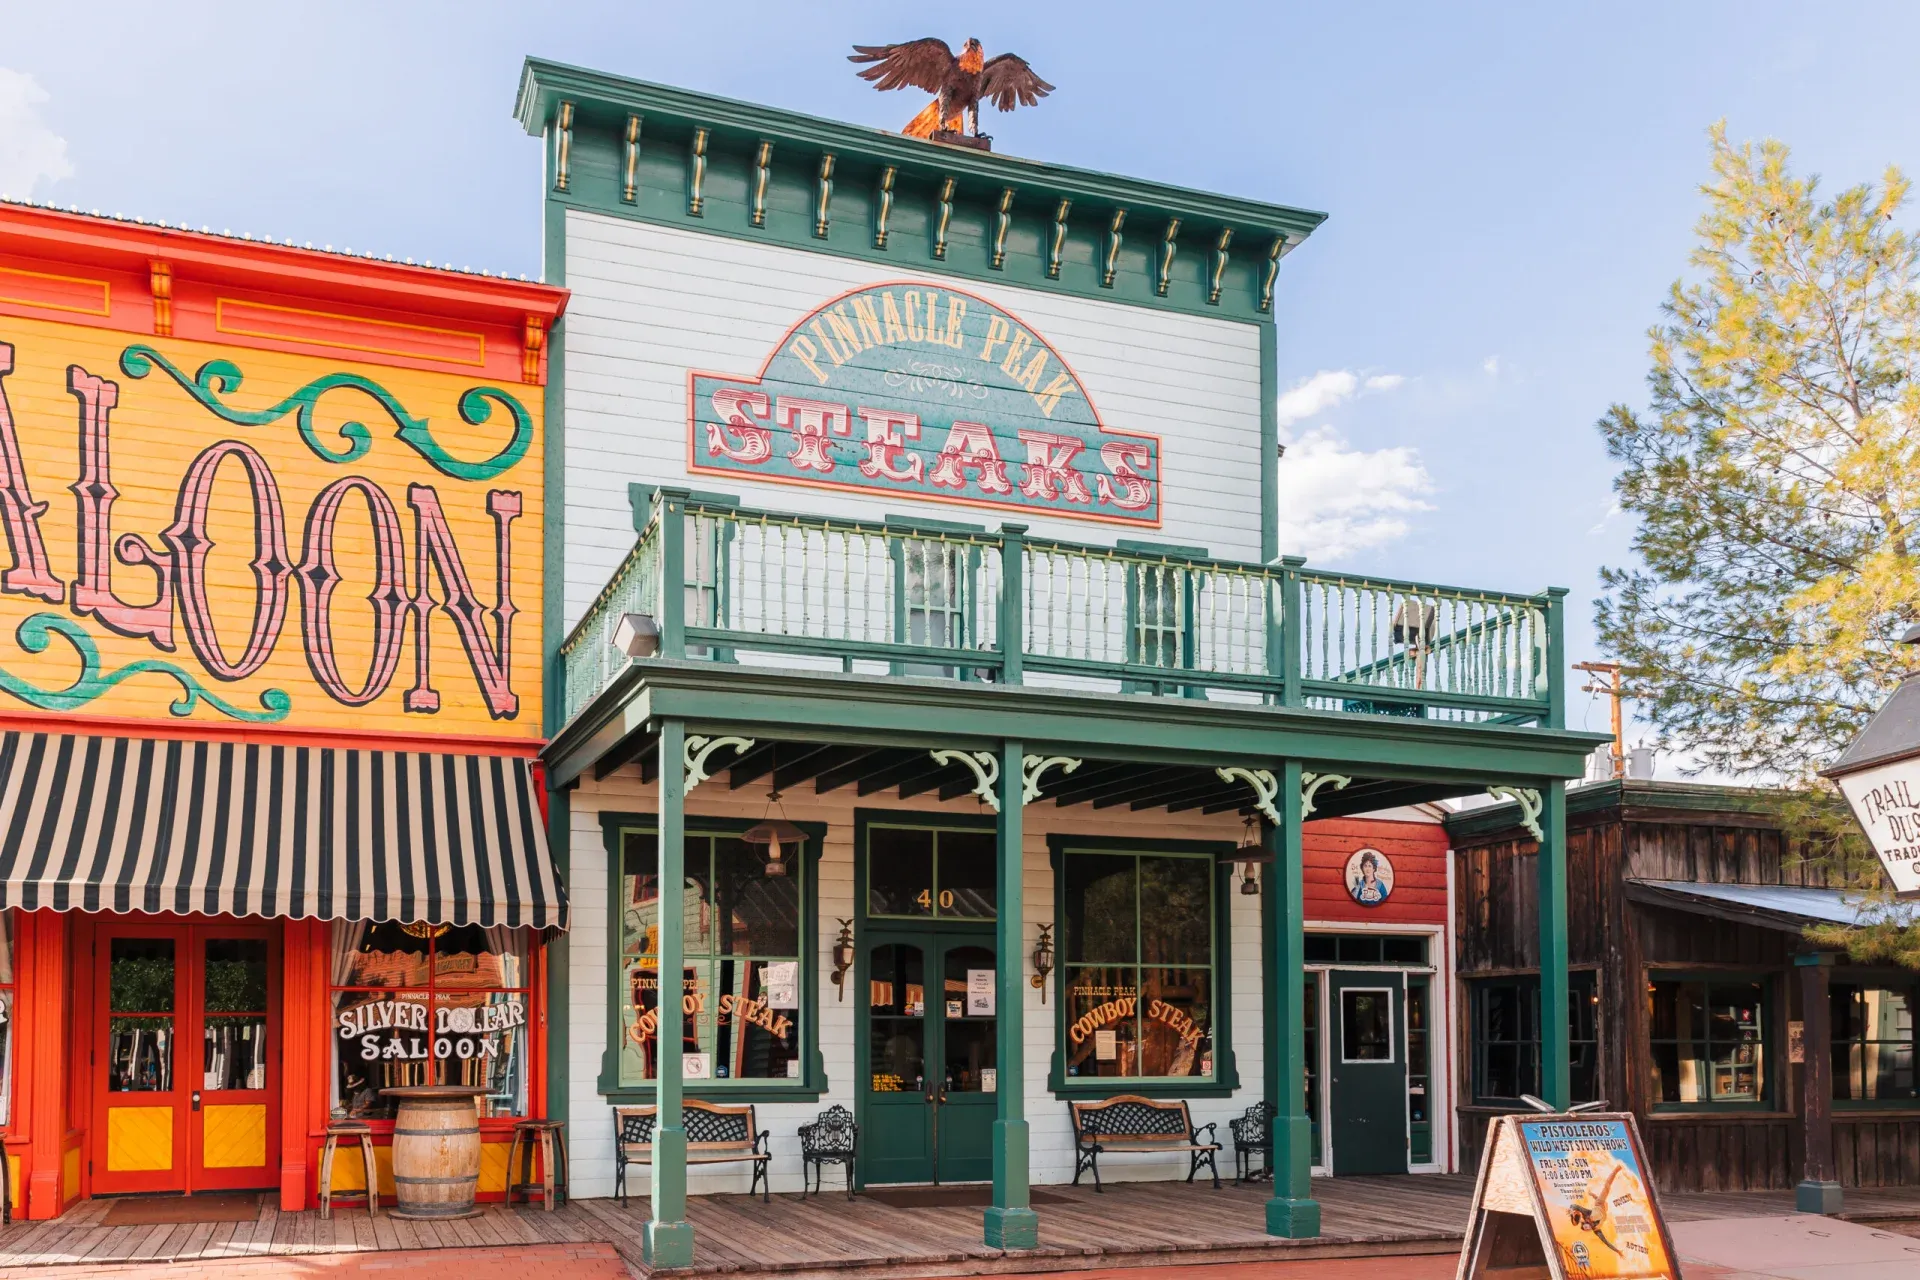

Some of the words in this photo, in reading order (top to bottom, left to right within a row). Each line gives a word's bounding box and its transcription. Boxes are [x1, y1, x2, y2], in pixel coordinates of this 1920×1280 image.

[790, 290, 966, 385] PINNACLE
[980, 314, 1078, 417] PEAK
[706, 388, 1152, 510] STEAKS
[1861, 780, 1920, 824] TRAIL
[917, 889, 954, 909] 40
[1073, 986, 1111, 996] PINNACLE
[1113, 986, 1136, 996] PEAK
[338, 1001, 429, 1040] SILVER
[629, 993, 707, 1043] COOY
[718, 994, 793, 1039] STEAK
[1070, 997, 1137, 1045] COWBOY
[1149, 999, 1205, 1051] STEAK
[361, 1034, 500, 1061] SALOON
[1540, 1124, 1611, 1138] PISTOLEROS
[1530, 1140, 1552, 1153] WILD
[1552, 1140, 1574, 1152] WEST
[1574, 1140, 1600, 1152] STUNT
[1600, 1138, 1628, 1151] SHOWS
[1539, 1159, 1553, 1169] FRI
[1556, 1159, 1570, 1169] SAT
[1574, 1158, 1589, 1168] SUN
[1543, 1170, 1558, 1180] 7:00
[1559, 1171, 1565, 1180] &
[1564, 1170, 1579, 1180] 8:00
[1580, 1169, 1593, 1179] PM
[1626, 1241, 1649, 1255] ACTION
